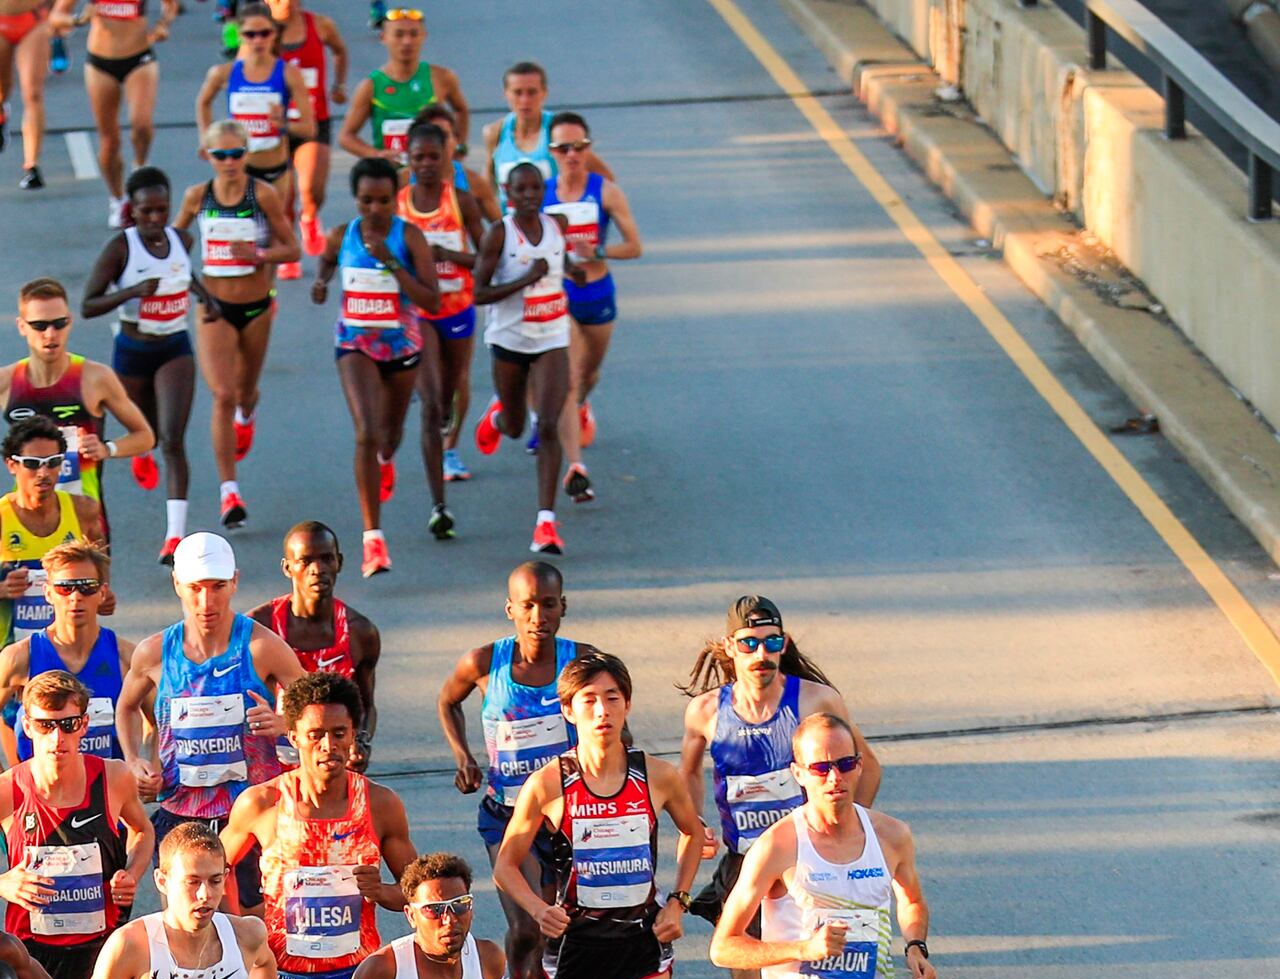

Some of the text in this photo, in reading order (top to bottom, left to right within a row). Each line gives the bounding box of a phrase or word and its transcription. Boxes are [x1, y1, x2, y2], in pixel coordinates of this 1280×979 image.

[347, 297, 394, 314] DIBABA
[176, 735, 241, 755] PUSKEDRA
[571, 802, 618, 818] MHPS
[576, 857, 650, 878] MATSUMURA
